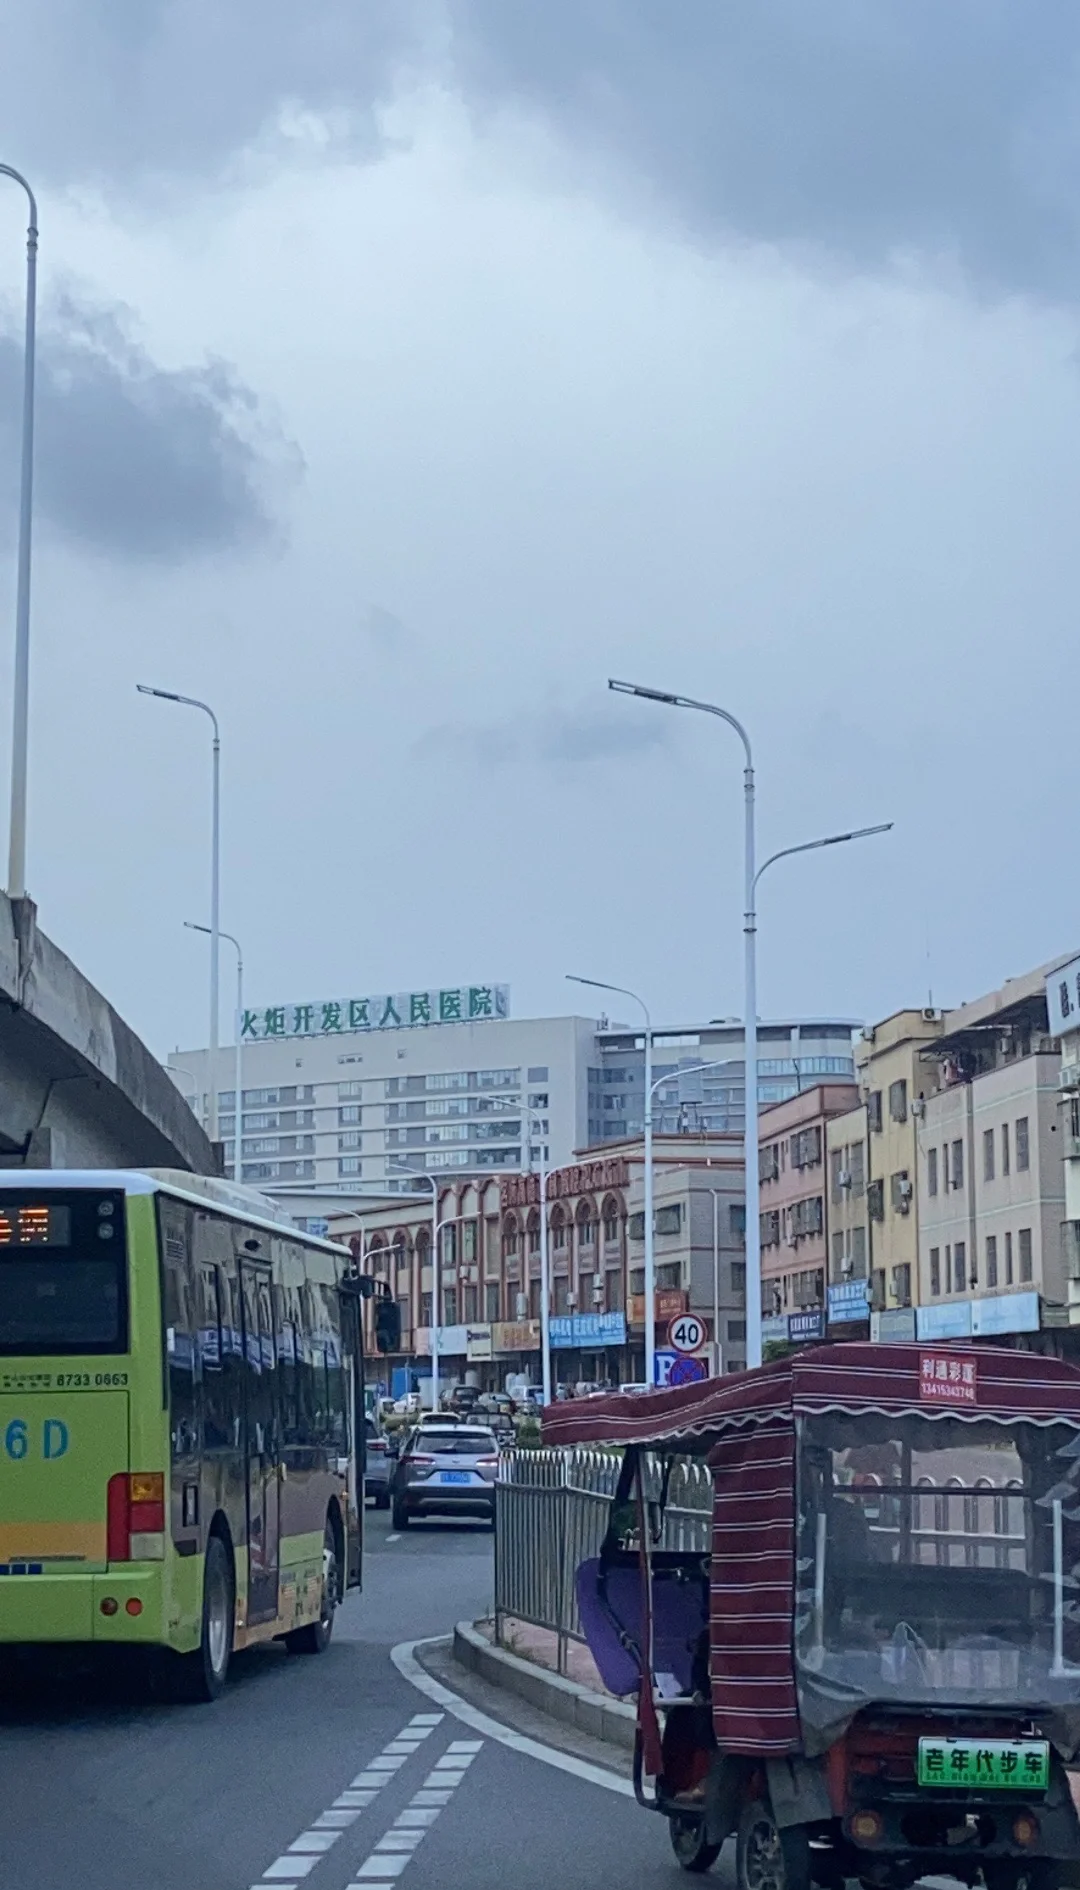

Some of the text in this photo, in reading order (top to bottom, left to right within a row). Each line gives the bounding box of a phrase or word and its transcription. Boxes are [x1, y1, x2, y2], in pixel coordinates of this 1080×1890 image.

[241, 986, 492, 1037] 火炬开发区人民医院
[674, 1323, 699, 1344] 40
[656, 1355, 677, 1386] P
[926, 1748, 1043, 1774] 老年代步车
